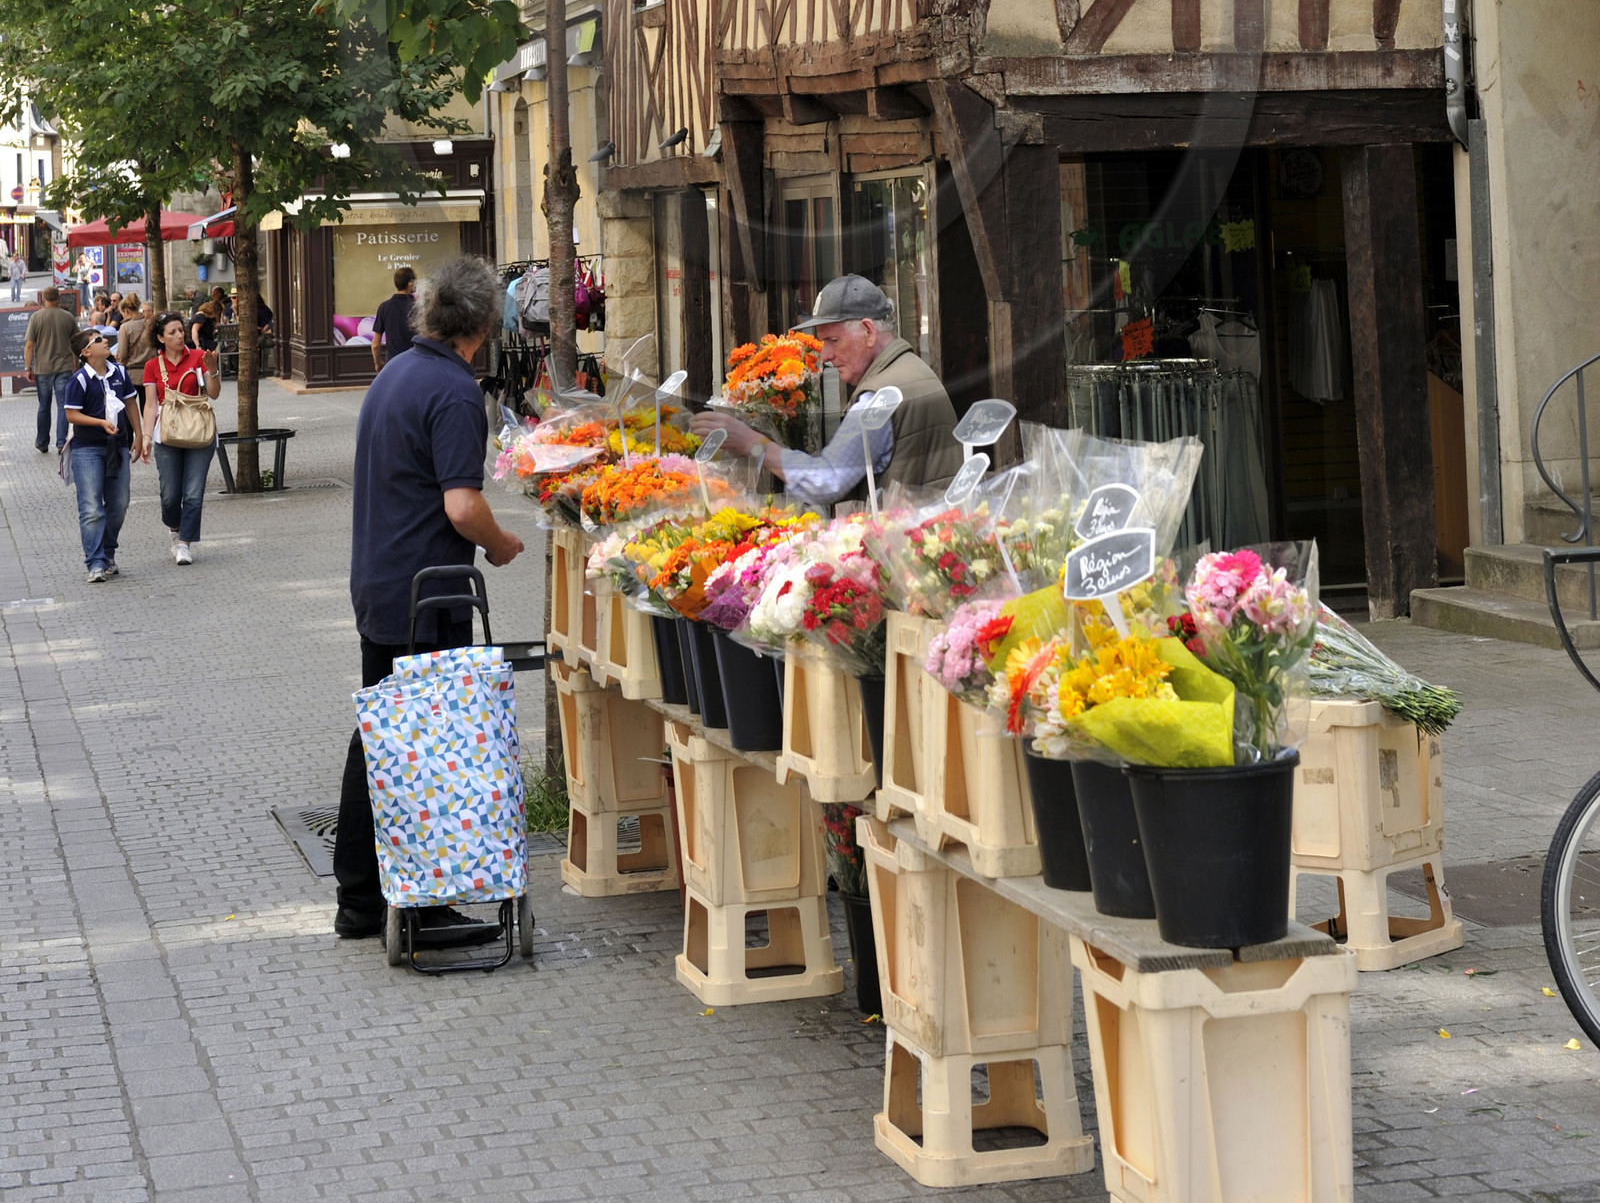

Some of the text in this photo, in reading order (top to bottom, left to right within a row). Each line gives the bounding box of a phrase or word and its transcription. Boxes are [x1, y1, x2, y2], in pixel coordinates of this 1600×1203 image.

[356, 229, 439, 245] Pâtisserie
[377, 253, 421, 262] Le Grenier
[1080, 544, 1142, 581] Région
[1081, 577, 1097, 597] 3
